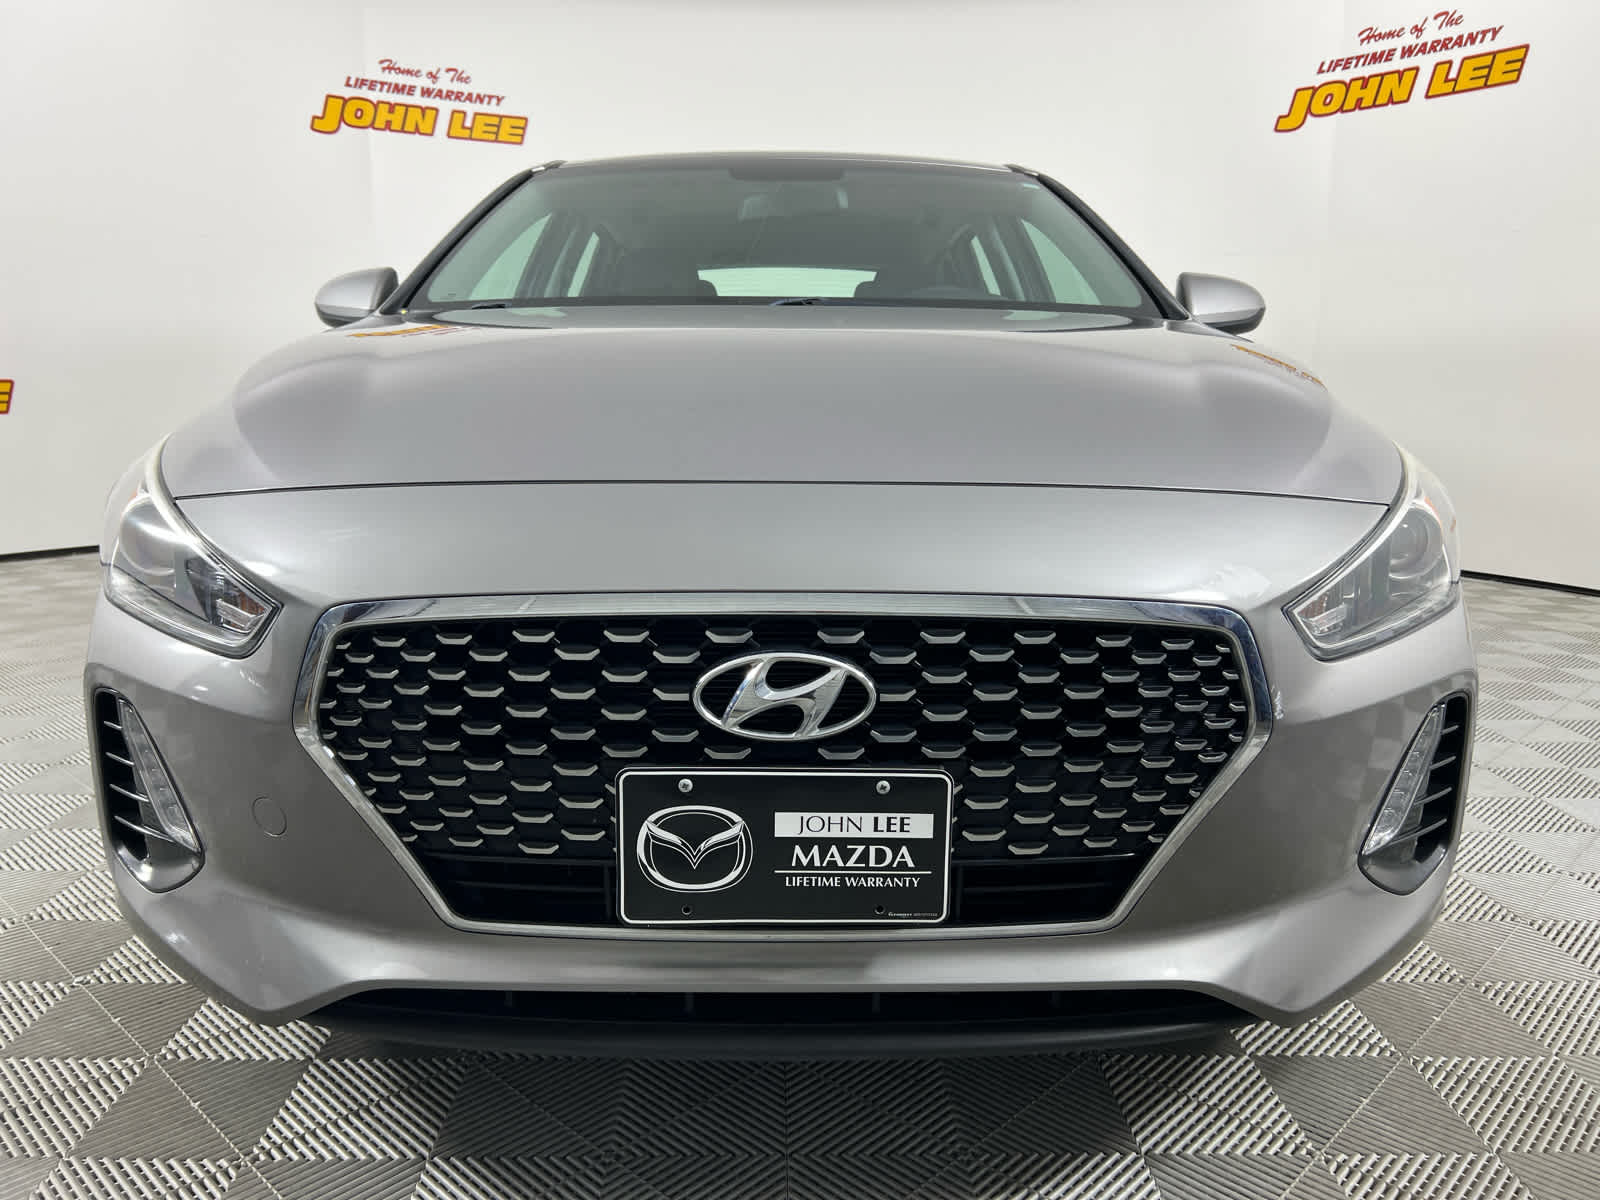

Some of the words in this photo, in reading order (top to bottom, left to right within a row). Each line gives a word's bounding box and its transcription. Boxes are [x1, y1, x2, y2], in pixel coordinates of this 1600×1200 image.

[1358, 27, 1405, 46] Home
[1410, 17, 1428, 39] of
[1433, 9, 1463, 31] The
[1317, 48, 1396, 75] LIFETIME
[1400, 25, 1504, 59] WARRANTY
[378, 59, 422, 77] Home
[426, 68, 440, 84] of
[445, 68, 472, 84] The
[344, 76, 416, 96] LIFETIME
[420, 85, 505, 106] WARRANTY
[1274, 66, 1420, 132] JOHN
[1424, 44, 1529, 99] LEE
[310, 94, 439, 136] JOHN
[447, 109, 528, 145] LEE
[798, 816, 862, 835] JOHN
[873, 816, 911, 832] LEE
[792, 844, 915, 867] MAZDA
[785, 876, 842, 887] LIFETIME
[845, 877, 920, 888] WARRANTY
